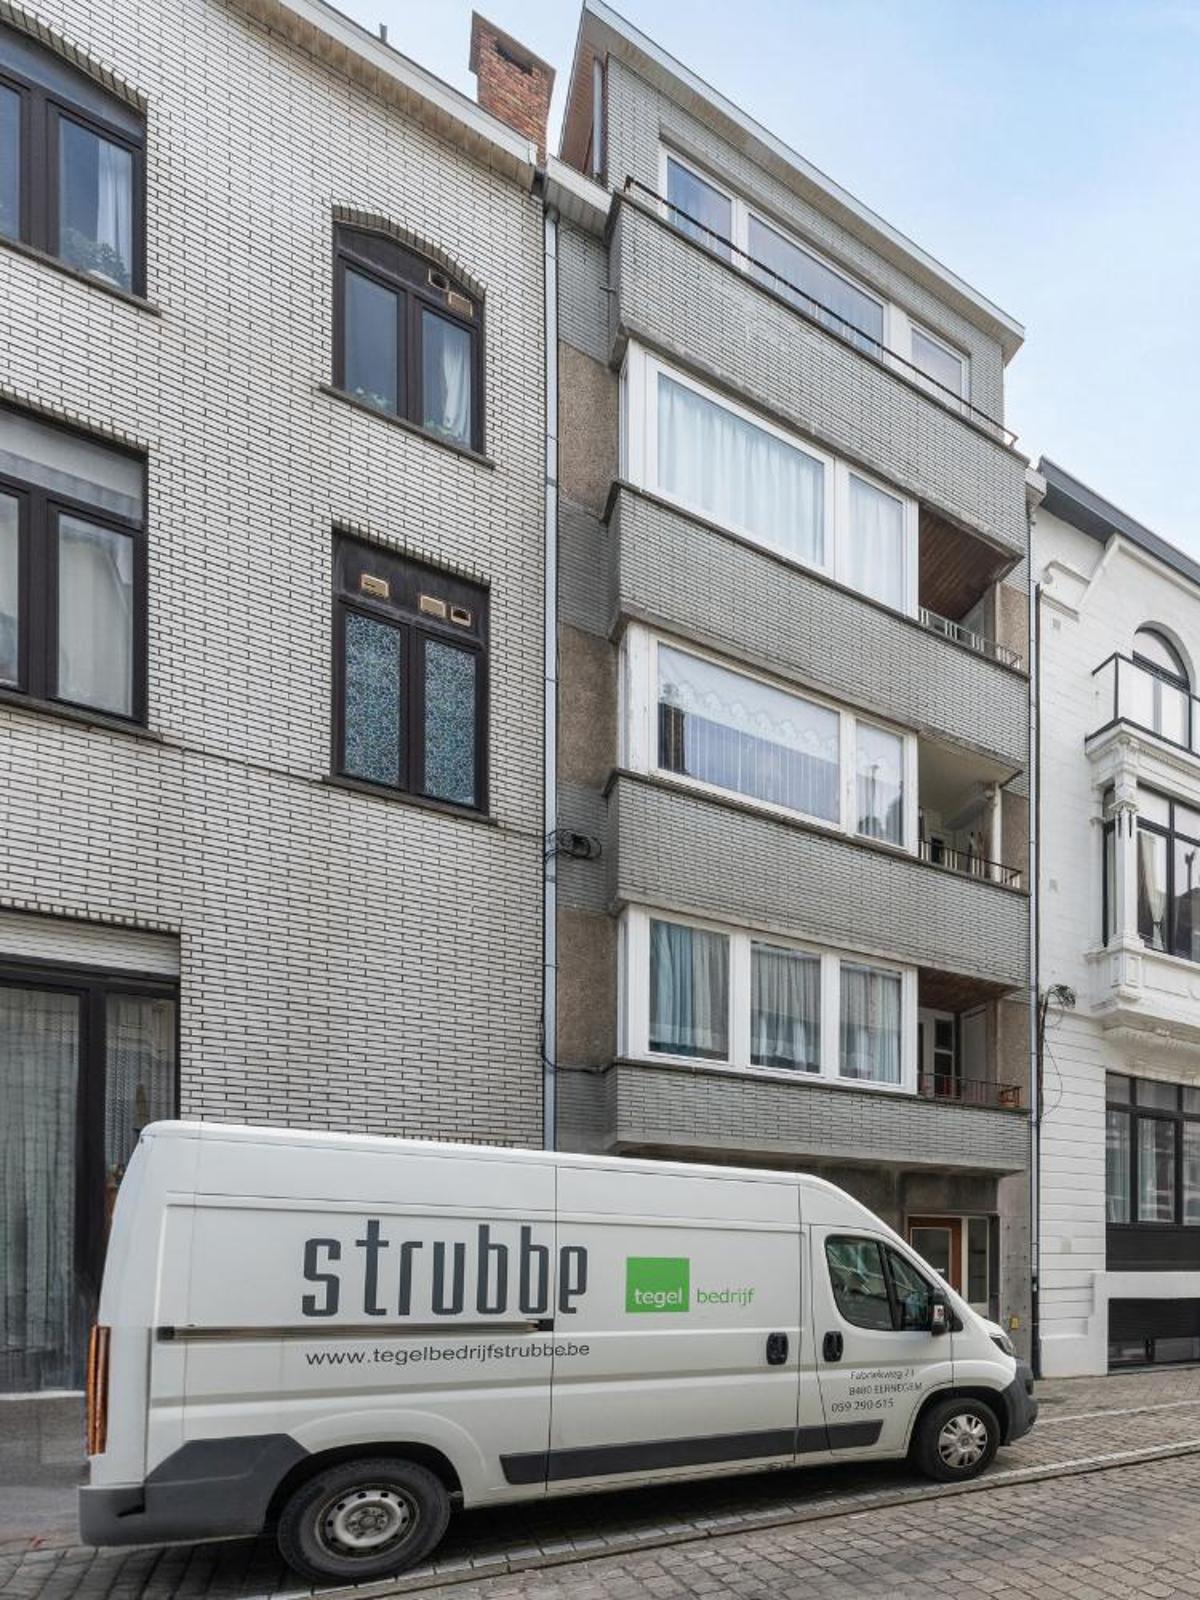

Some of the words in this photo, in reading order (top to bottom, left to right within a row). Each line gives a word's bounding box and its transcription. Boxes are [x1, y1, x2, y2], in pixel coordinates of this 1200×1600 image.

[301, 1219, 588, 1317] strubbe
[634, 1287, 682, 1308] tegel
[696, 1287, 755, 1306] bedrijf
[306, 1341, 590, 1366] www.tegelbedrijfstrubbe.be
[831, 1401, 852, 1413] 059
